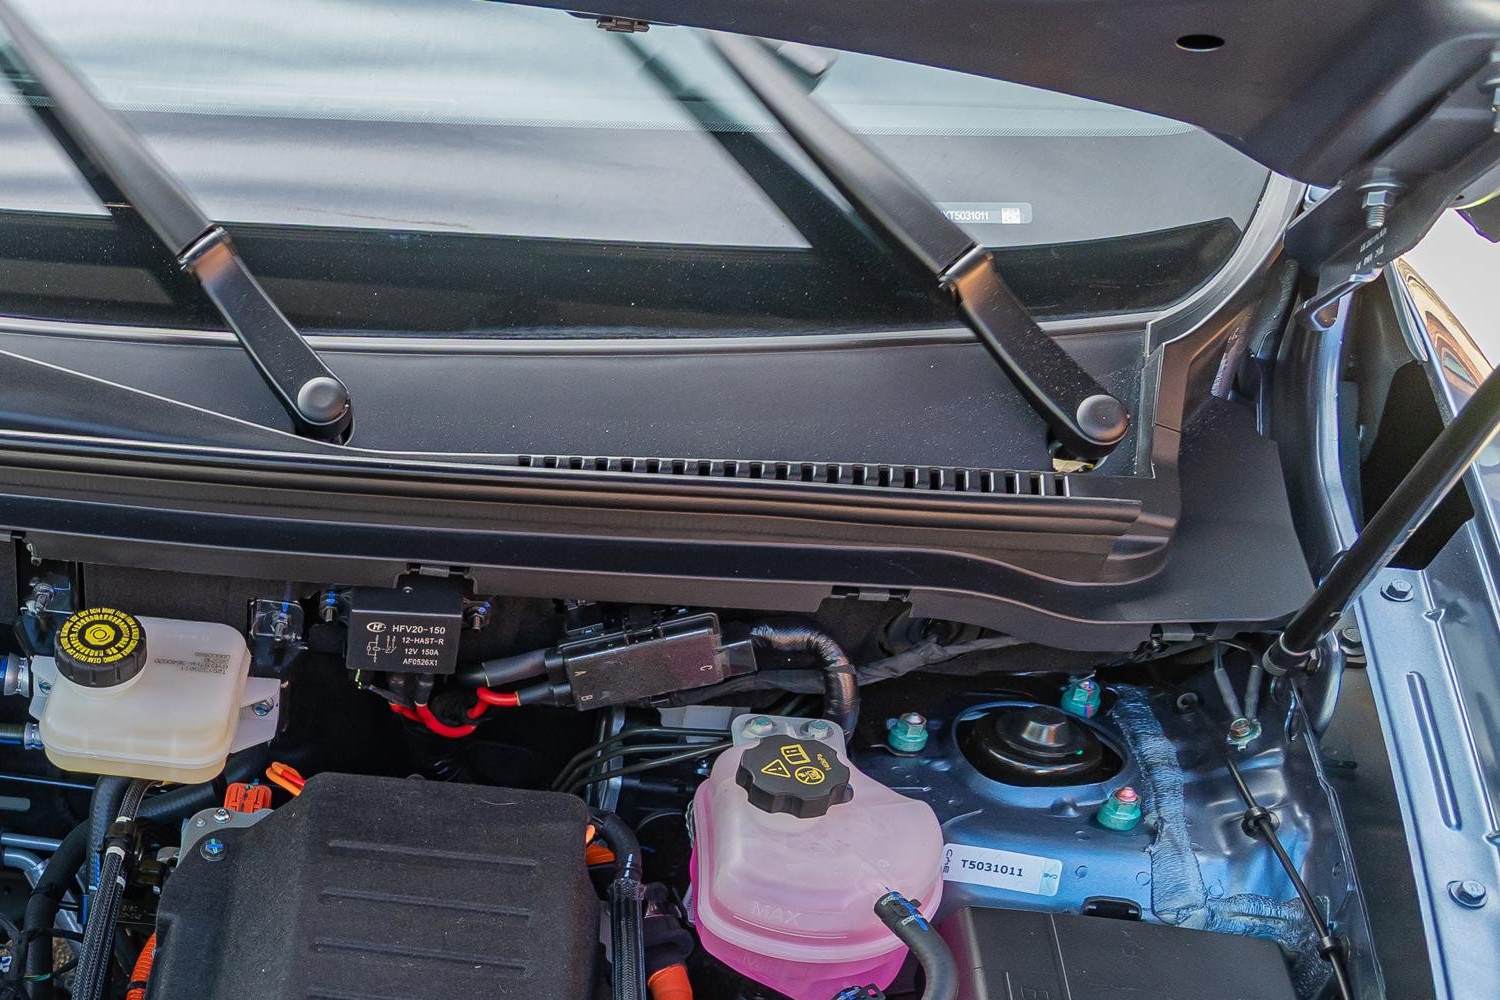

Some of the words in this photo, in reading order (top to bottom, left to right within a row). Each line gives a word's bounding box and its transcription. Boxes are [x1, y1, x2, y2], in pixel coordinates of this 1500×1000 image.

[392, 625, 446, 634] HFV20-150
[402, 637, 444, 645] 12-HAST-R
[421, 648, 439, 656] 150A
[943, 849, 953, 873] BYD
[961, 859, 1024, 877] T5031011
[752, 900, 803, 926] MAX
